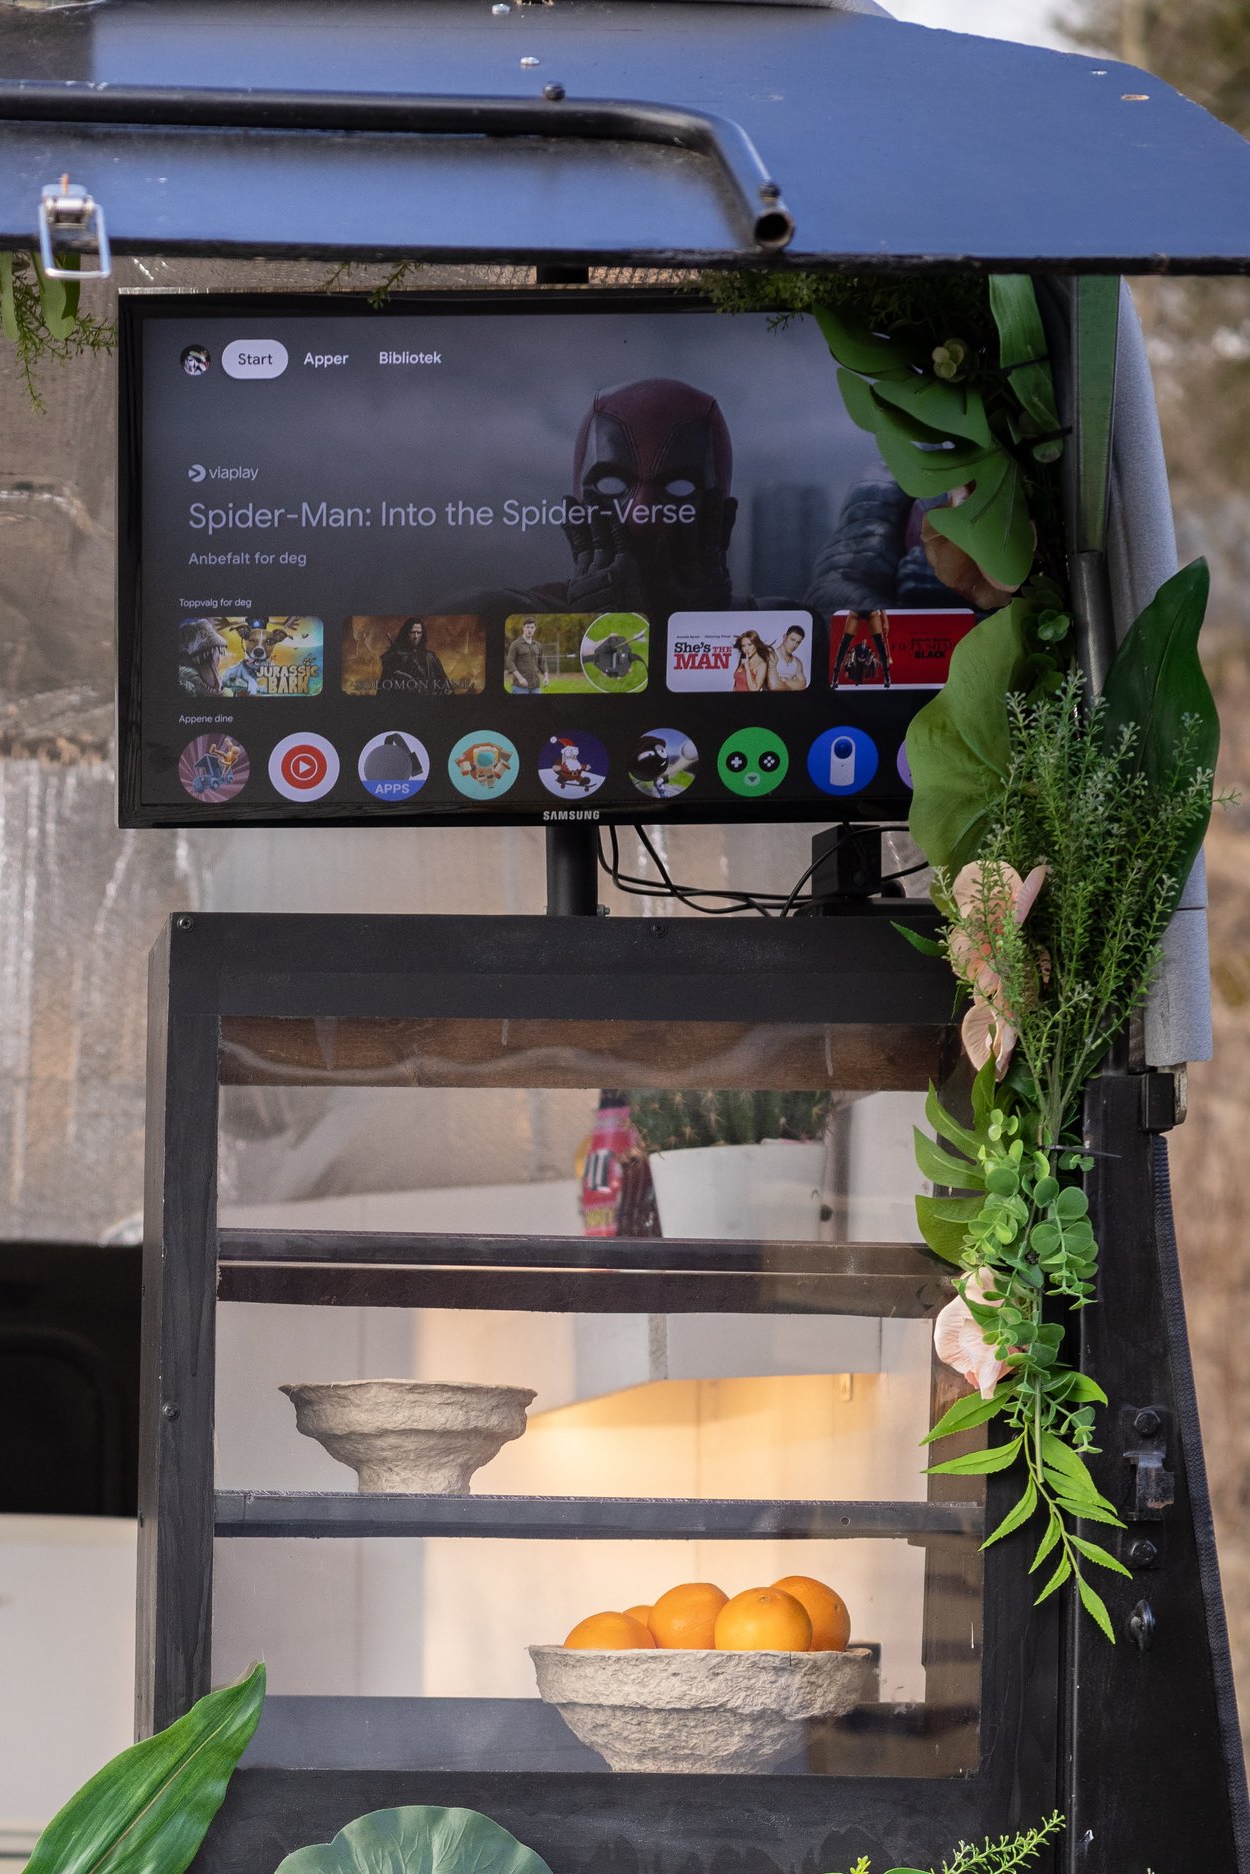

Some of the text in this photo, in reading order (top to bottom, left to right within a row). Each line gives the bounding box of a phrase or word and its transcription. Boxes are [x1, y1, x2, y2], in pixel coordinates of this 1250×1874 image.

[237, 352, 273, 366] Start
[303, 352, 349, 369] Apper
[379, 351, 442, 365] Bibliotek
[209, 465, 259, 482] viaplay
[188, 498, 696, 536] Spider-Man: Into the Spider-Verse
[188, 552, 307, 567] Anbefalt for deg
[179, 597, 252, 609] Toppvalg for deg
[673, 641, 712, 653] She's
[673, 653, 732, 670] MAN
[256, 665, 319, 678] JURASSIC
[268, 676, 310, 693] BARK
[355, 679, 429, 690] SOLOMON
[178, 713, 234, 725] Appene dine
[375, 783, 410, 794] APPS
[543, 810, 600, 820] SAMSUNG
